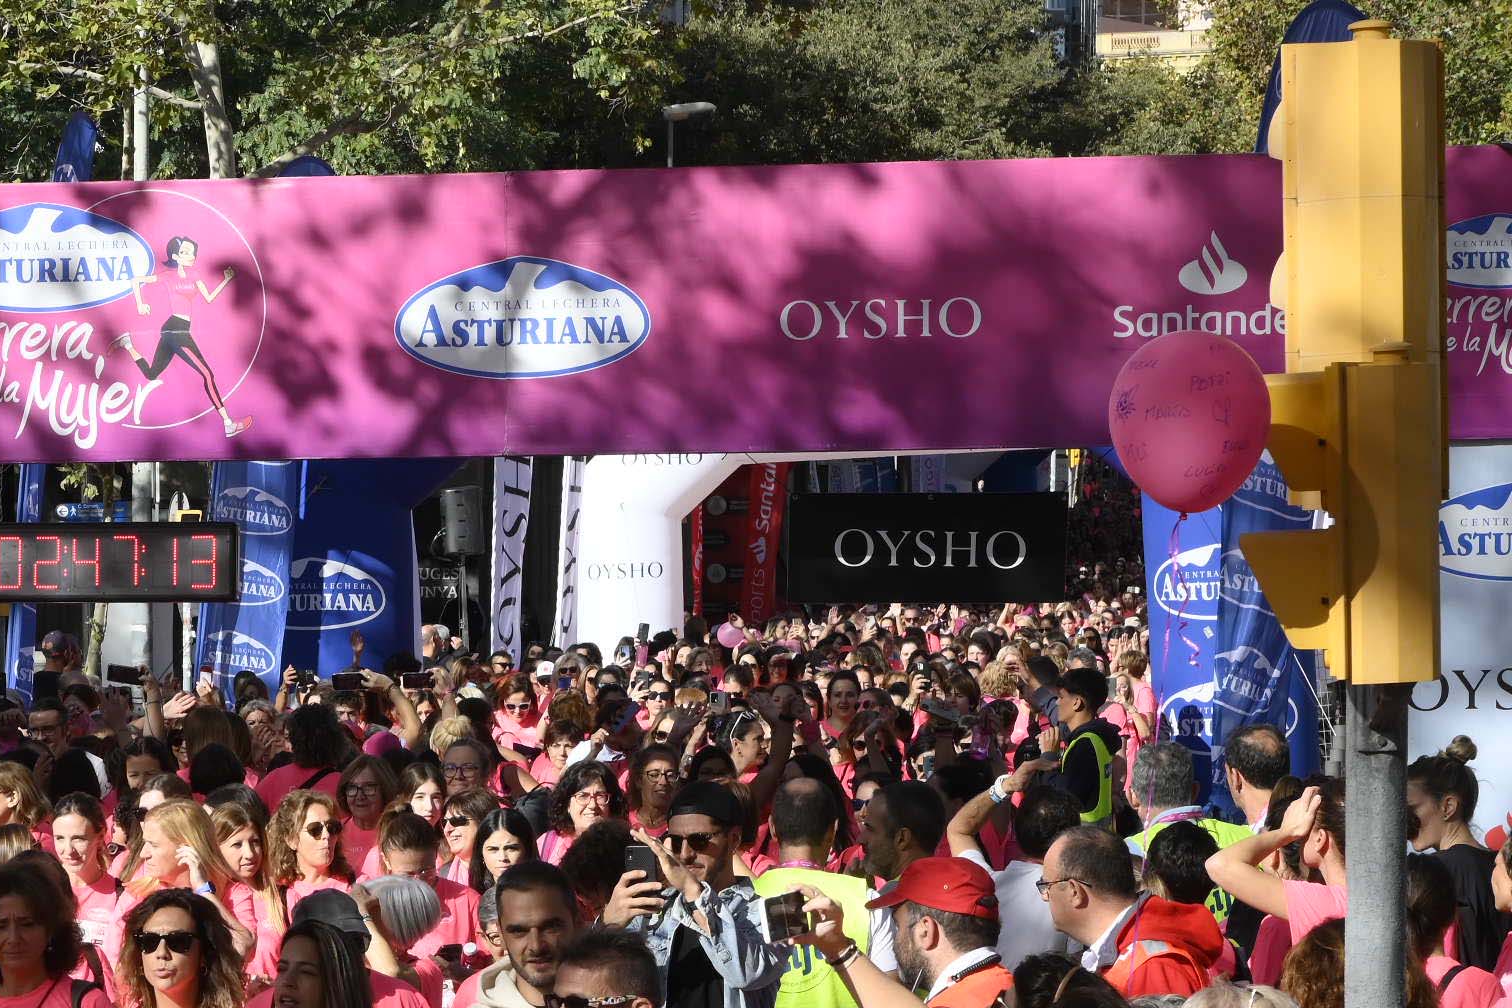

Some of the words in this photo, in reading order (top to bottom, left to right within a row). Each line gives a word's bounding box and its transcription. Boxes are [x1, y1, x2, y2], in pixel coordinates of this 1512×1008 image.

[57, 239, 128, 252] LECHERA
[1447, 251, 1512, 270] STUR
[454, 299, 533, 313] CENTRAL
[779, 296, 983, 341] OYSHO
[1112, 303, 1288, 339] Santande
[414, 303, 630, 349] ASTURIANA
[13, 356, 164, 450] Mujer
[834, 528, 1028, 569] OYSHO
[588, 560, 664, 580] OYSHO
